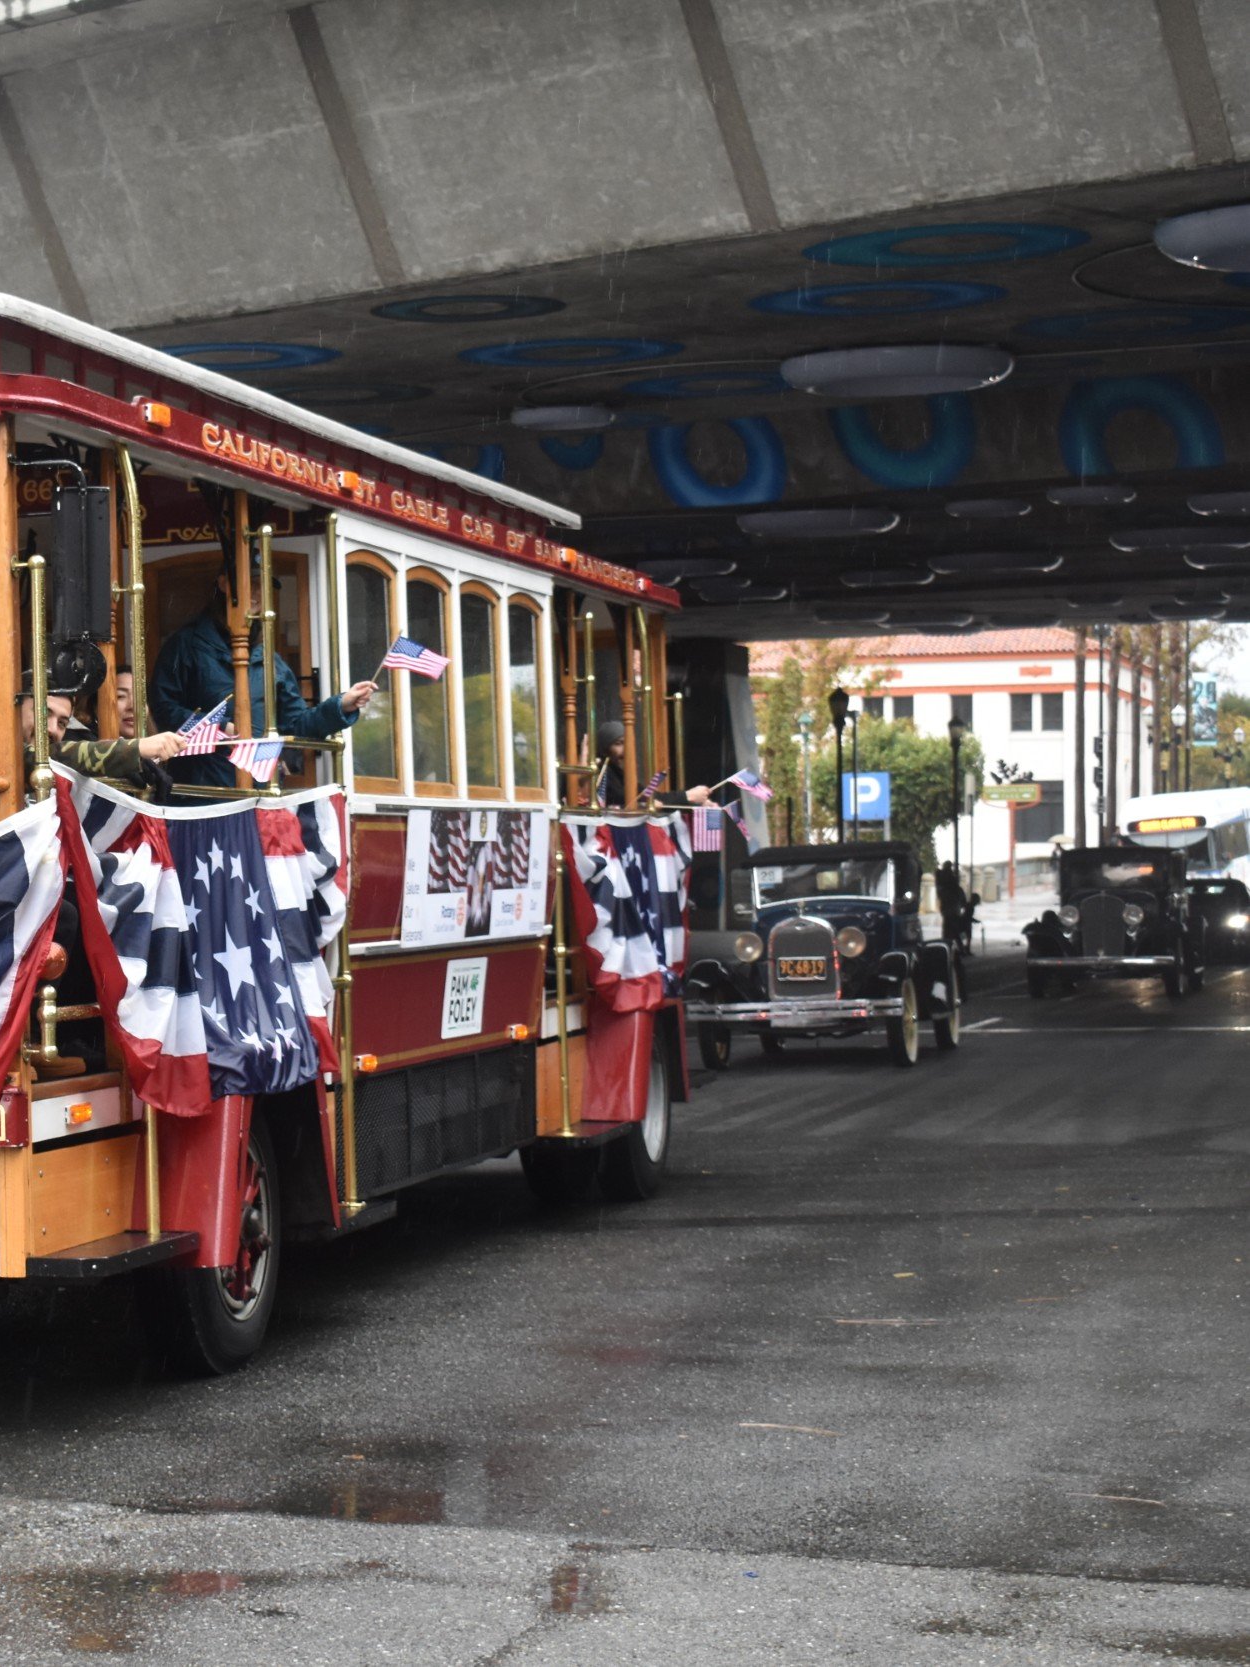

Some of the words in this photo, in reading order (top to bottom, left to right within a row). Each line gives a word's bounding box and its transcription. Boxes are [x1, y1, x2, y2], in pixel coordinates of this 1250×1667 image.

[201, 422, 342, 495] CALIFORNIA
[390, 490, 450, 530] CABLE
[461, 514, 495, 546] CAR
[506, 530, 526, 555] OF
[572, 552, 636, 590] RANCISCO
[850, 776, 881, 816] P
[451, 974, 470, 997] PAM
[447, 997, 478, 1024] FOLEY
